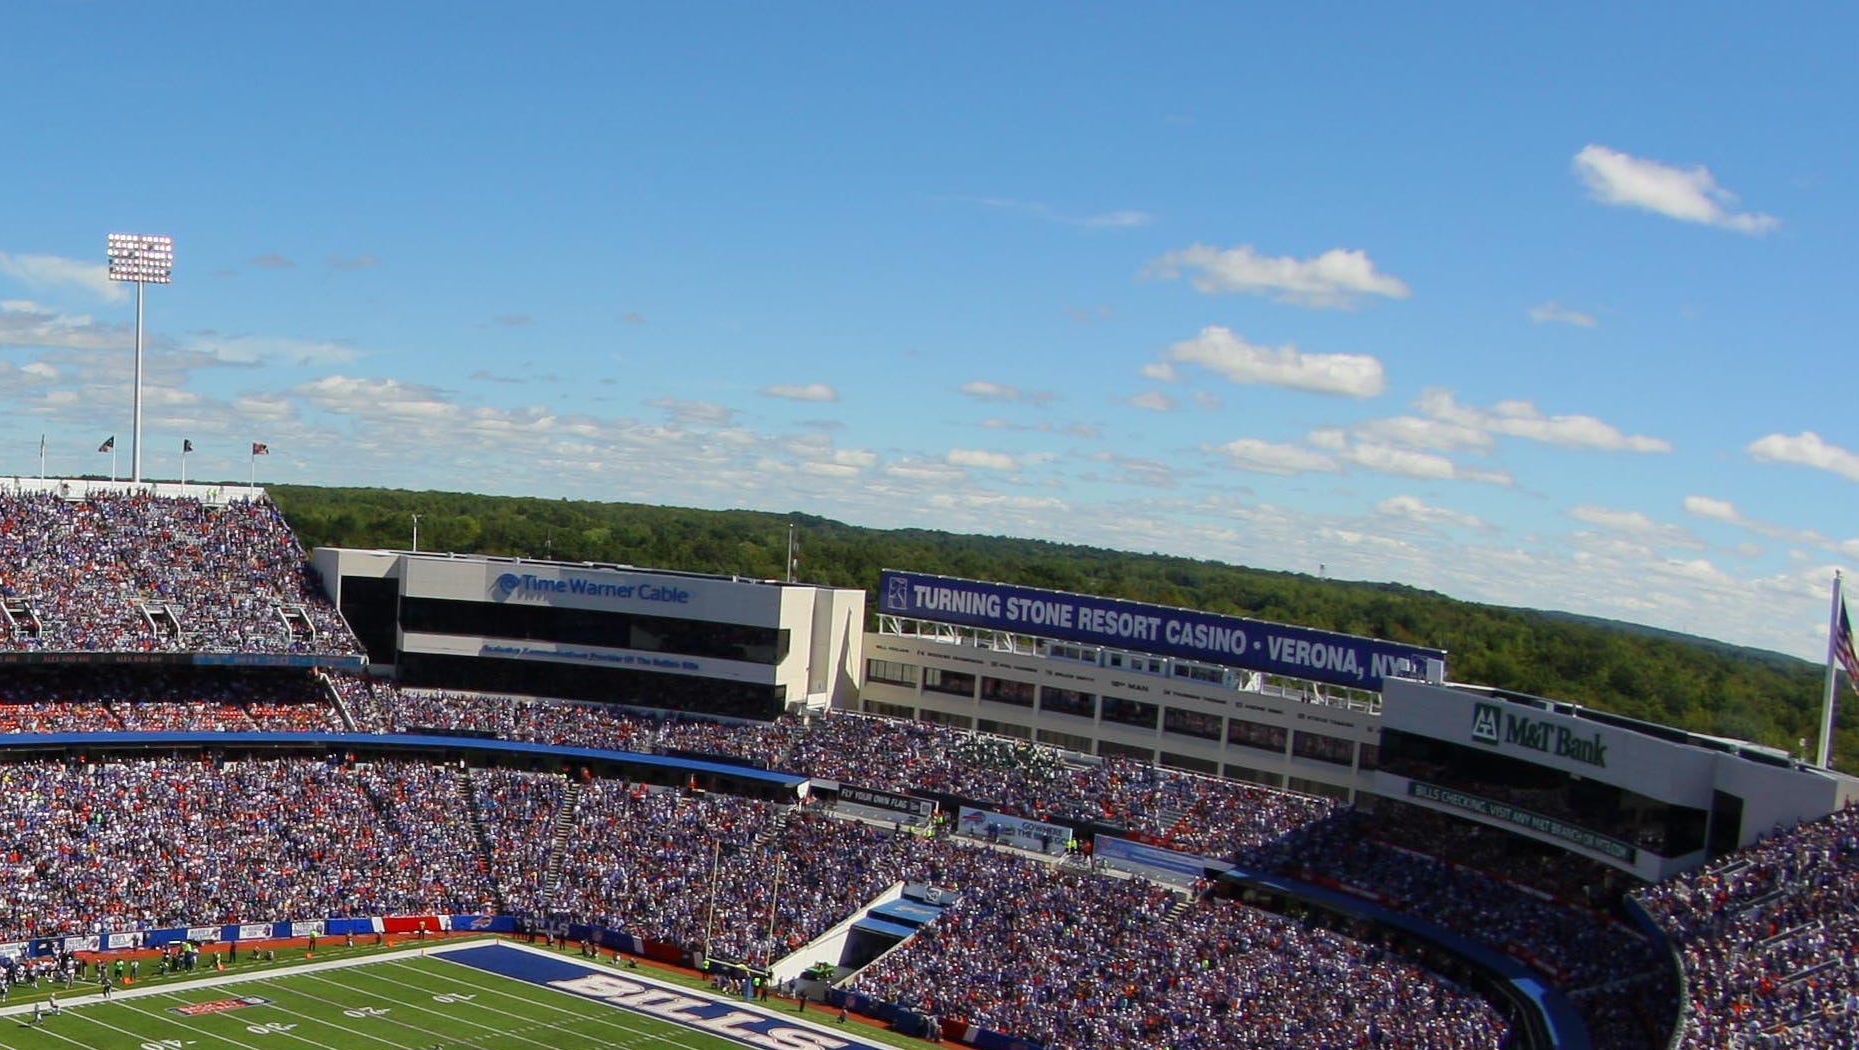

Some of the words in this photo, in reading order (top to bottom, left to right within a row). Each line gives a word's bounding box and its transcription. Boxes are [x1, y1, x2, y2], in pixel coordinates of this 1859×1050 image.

[521, 574, 566, 593] Time
[569, 579, 635, 598] Warner
[638, 584, 690, 604] Cable
[913, 585, 1002, 619] TURNING
[1006, 596, 1073, 629] STONE
[1078, 607, 1162, 641] RESORT
[1166, 619, 1247, 655] CASINO
[1267, 635, 1365, 680] VERONA,
[1505, 714, 1556, 754] M&T
[1555, 725, 1608, 769] Bank
[841, 788, 854, 799] FLY
[855, 791, 873, 802] YOUR
[873, 795, 890, 805] OWN
[891, 797, 908, 809] FLAG
[1414, 784, 1441, 801] BILLS
[1490, 803, 1512, 822] VISIT
